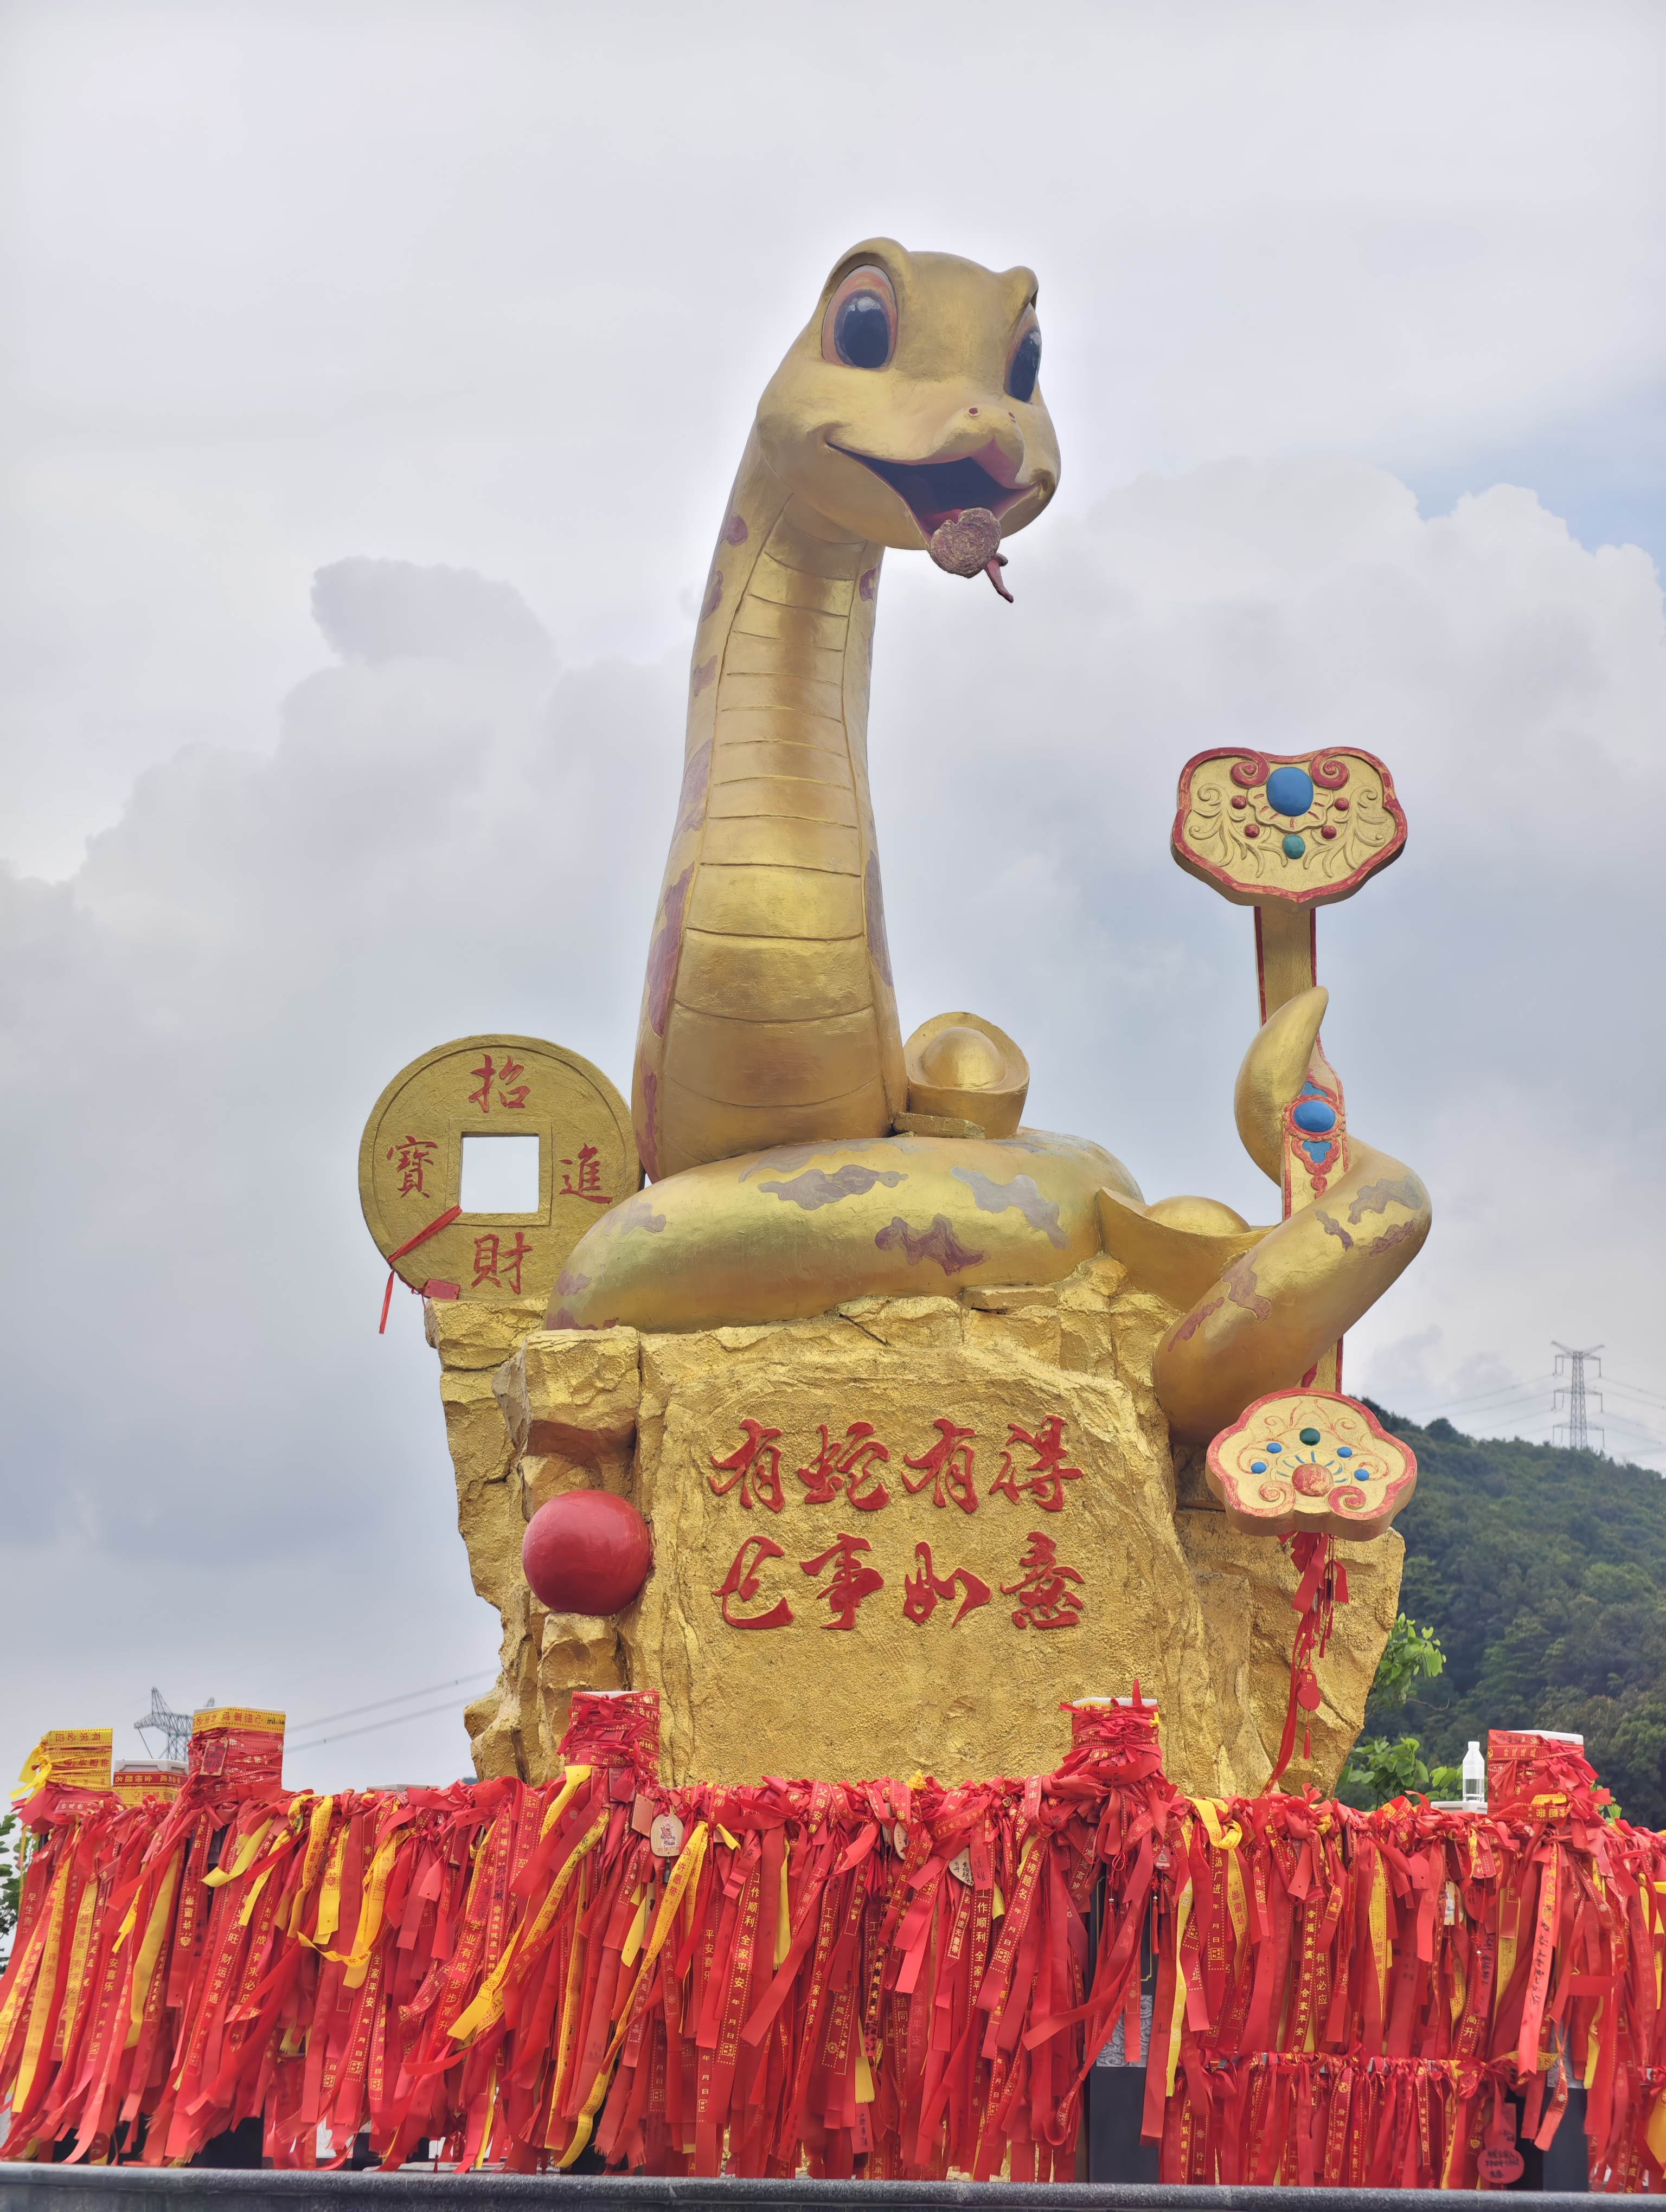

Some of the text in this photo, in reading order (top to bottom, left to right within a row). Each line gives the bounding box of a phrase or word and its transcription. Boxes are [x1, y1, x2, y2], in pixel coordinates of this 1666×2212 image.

[468, 1054, 530, 1113] 招
[559, 1143, 612, 1204] 進
[472, 1232, 533, 1294] 財
[708, 1414, 1084, 1513] 有蛇有得
[56, 1733, 101, 1742] 有求必应
[808, 1787, 828, 1835] 父母安康
[498, 1827, 509, 1857] 祈福带
[542, 1874, 569, 1920] 心想事成
[669, 1863, 687, 1896] 许愿带
[744, 1873, 760, 1927] 工作顺利
[1018, 1849, 1040, 1900] 金榜题名
[182, 1895, 195, 1931] 许愿带
[489, 1914, 501, 1947] 身体健康
[733, 1934, 751, 1989] 全家平安
[807, 1907, 834, 2025] 工作顺利 全家平安
[870, 1946, 886, 1999] 金榜题名
[971, 1888, 989, 2007] 工作顺利 全家平安
[1295, 1909, 1317, 2036] 幸福美满 合家平安
[208, 1953, 233, 2004] 财运亨通
[365, 1954, 382, 2008] 全家平安
[438, 1920, 482, 2031] 学业有成 步步高升
[1315, 1951, 1329, 2005] 有求必应
[1463, 2015, 1478, 2038] 高升
